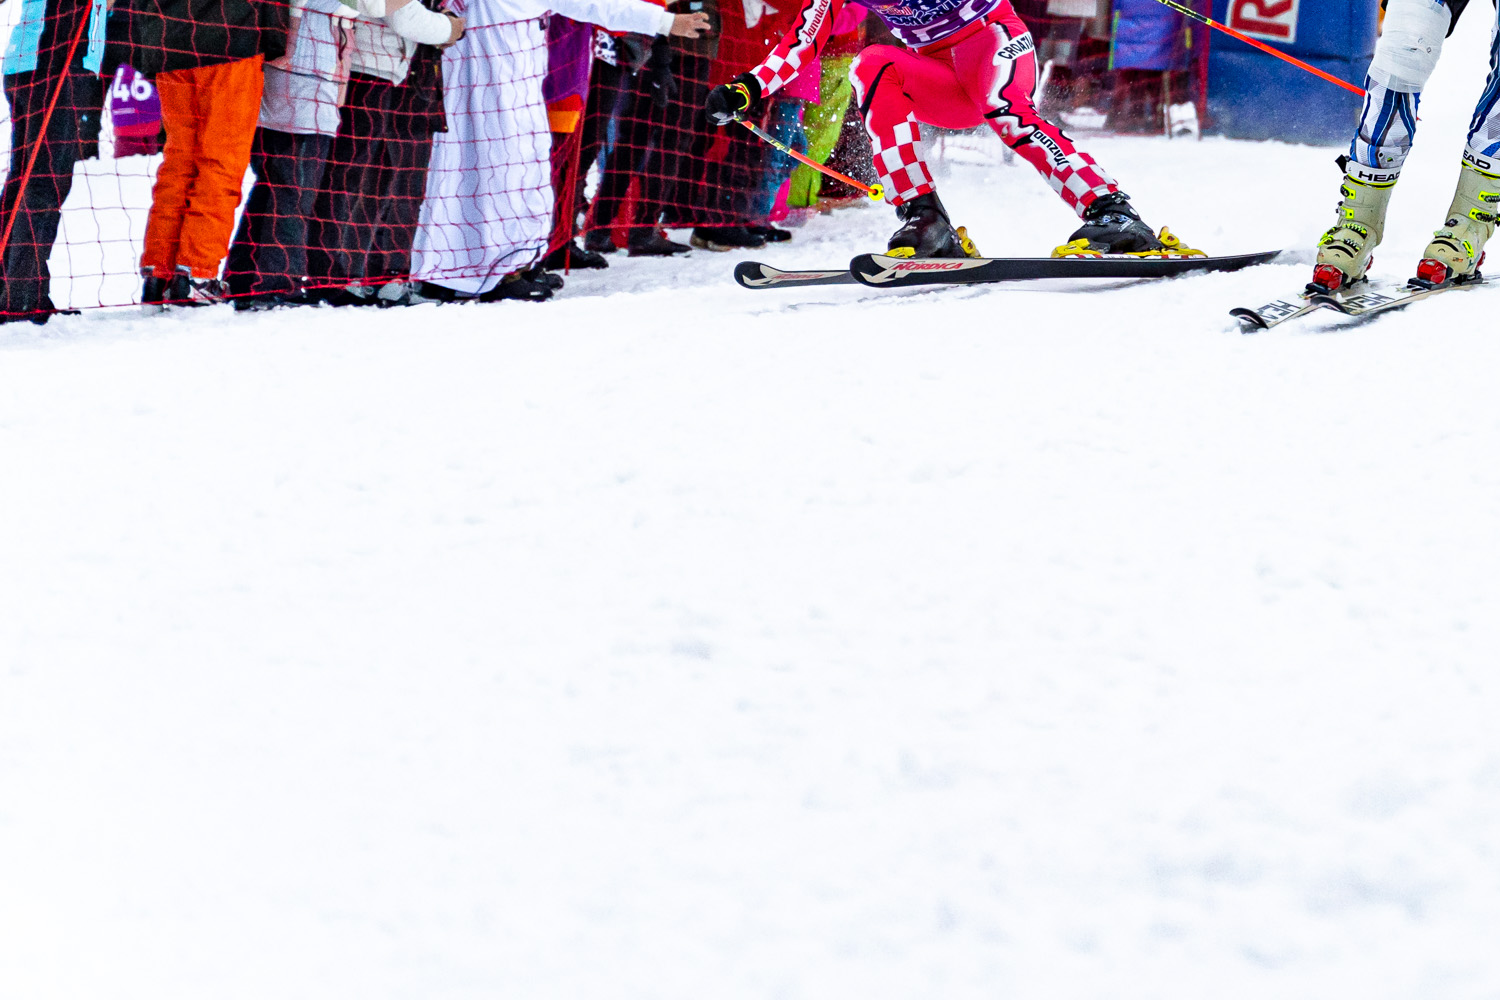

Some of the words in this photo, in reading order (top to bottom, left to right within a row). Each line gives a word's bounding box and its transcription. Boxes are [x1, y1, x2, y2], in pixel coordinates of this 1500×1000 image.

[112, 66, 153, 103] 46
[1033, 130, 1070, 166] MIZUNO
[1462, 151, 1491, 170] EAD
[892, 261, 963, 271] NORDICA
[1256, 299, 1302, 324] HEA
[1342, 292, 1396, 313] HEA
